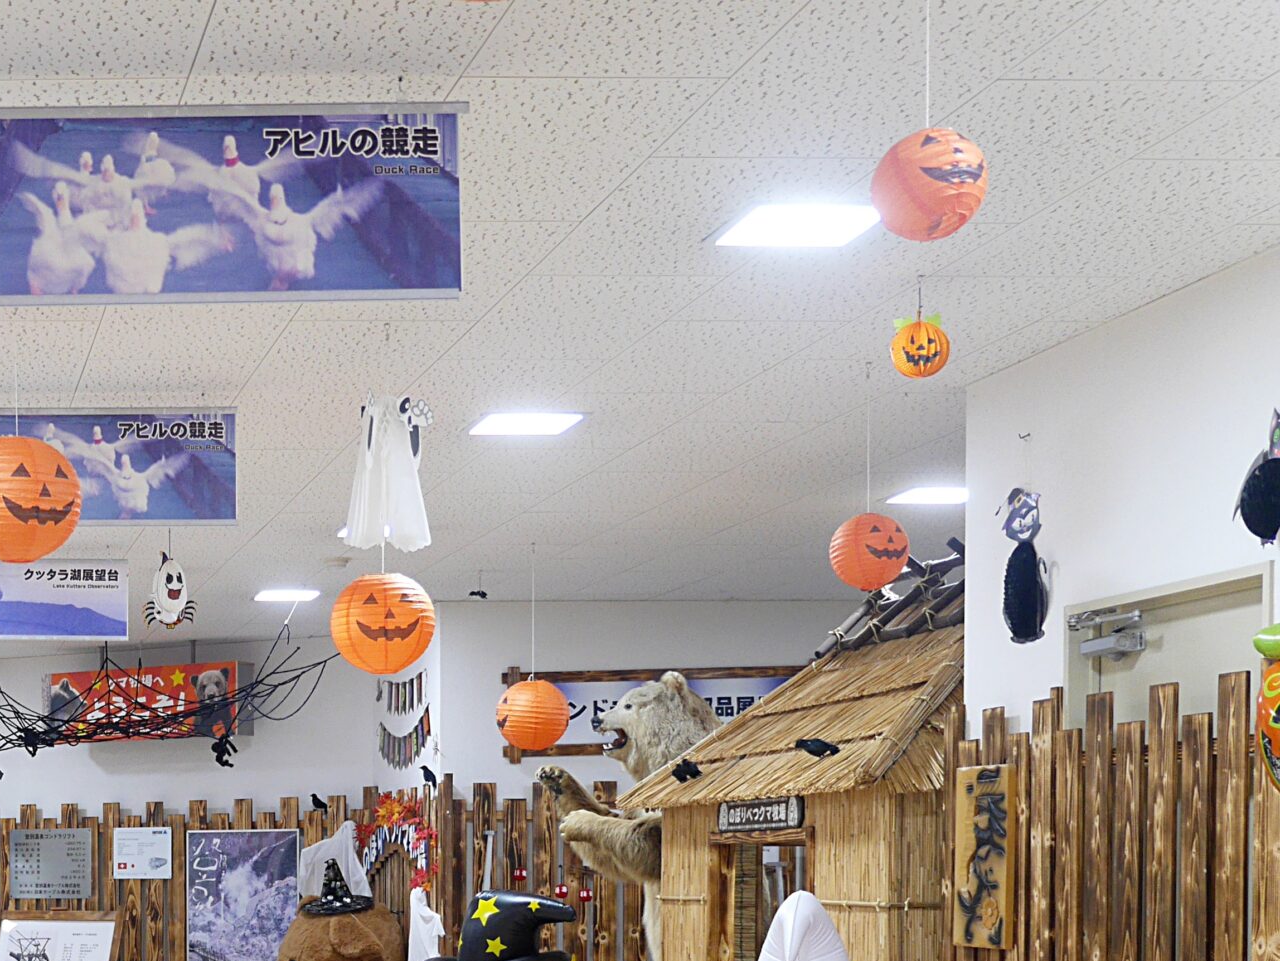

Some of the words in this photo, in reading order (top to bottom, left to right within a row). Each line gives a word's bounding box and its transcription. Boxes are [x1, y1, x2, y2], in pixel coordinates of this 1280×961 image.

[264, 126, 439, 158] アヒルの競走
[375, 165, 404, 175] Duck
[409, 165, 440, 175] Race
[118, 421, 224, 439] アヒルの競走
[24, 568, 119, 582] クッタラ湖展望台
[728, 803, 787, 824] のぼりべつクマ牧場
